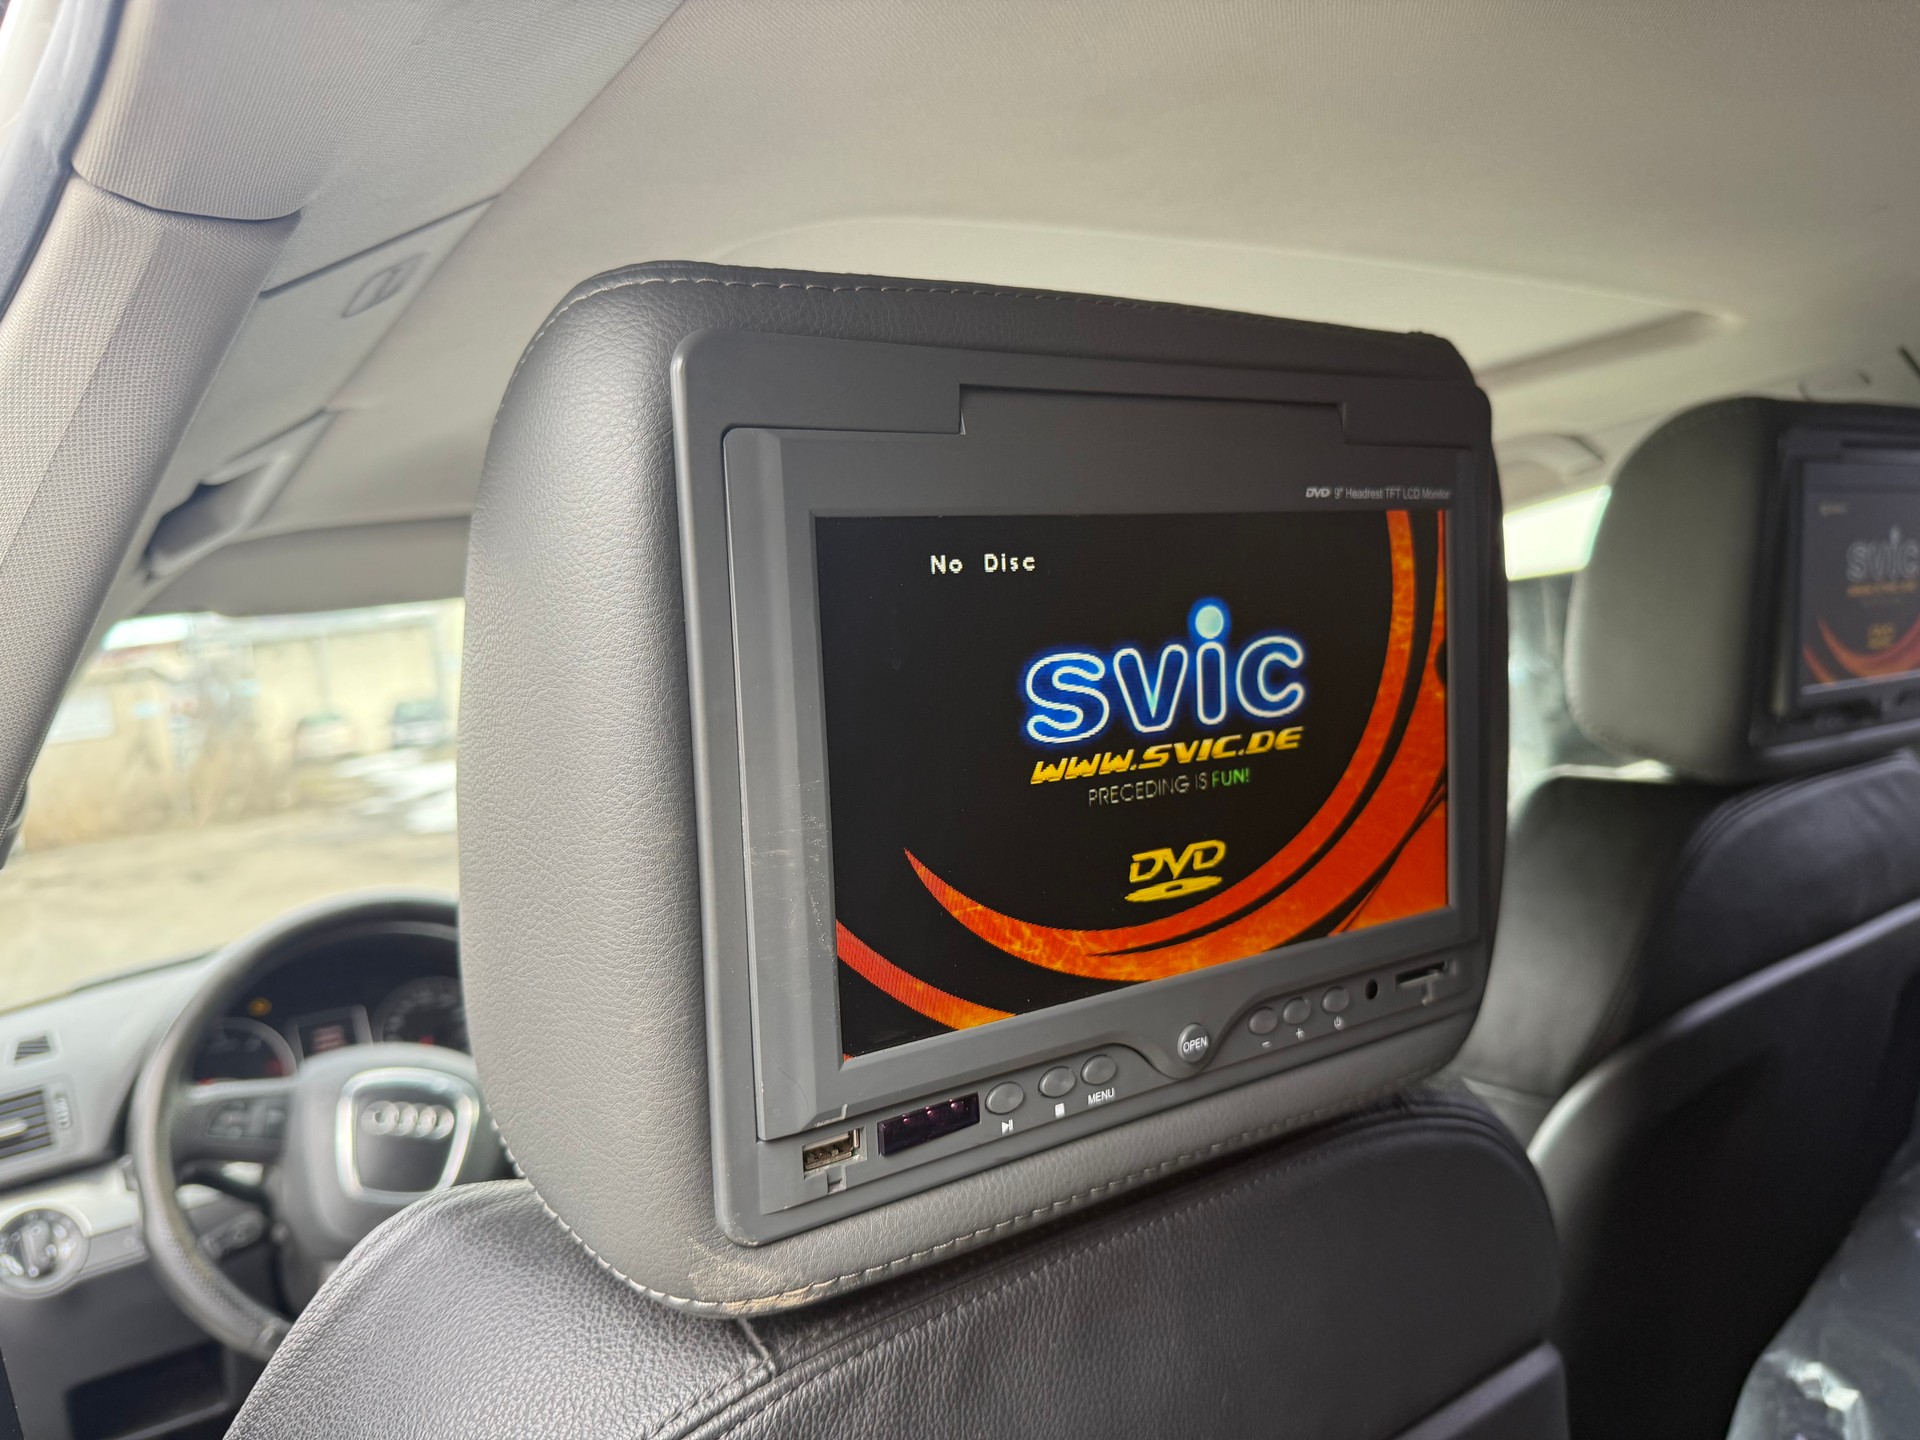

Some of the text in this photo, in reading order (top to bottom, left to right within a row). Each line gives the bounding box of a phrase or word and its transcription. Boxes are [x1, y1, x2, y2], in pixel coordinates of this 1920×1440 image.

[1305, 486, 1330, 498] DVD
[1345, 487, 1383, 500] Headrest
[1385, 488, 1401, 500] TFT
[1402, 488, 1420, 500] LCD
[1421, 488, 1451, 500] Monitor
[930, 552, 1036, 574] No Disc
[1030, 726, 1304, 785] WWW.SVIC.DE
[1088, 767, 1250, 807] PRECEDING IS FUN!
[1129, 839, 1226, 883] DVD
[1182, 1035, 1208, 1053] OPEN
[1087, 1087, 1116, 1106] MENU
